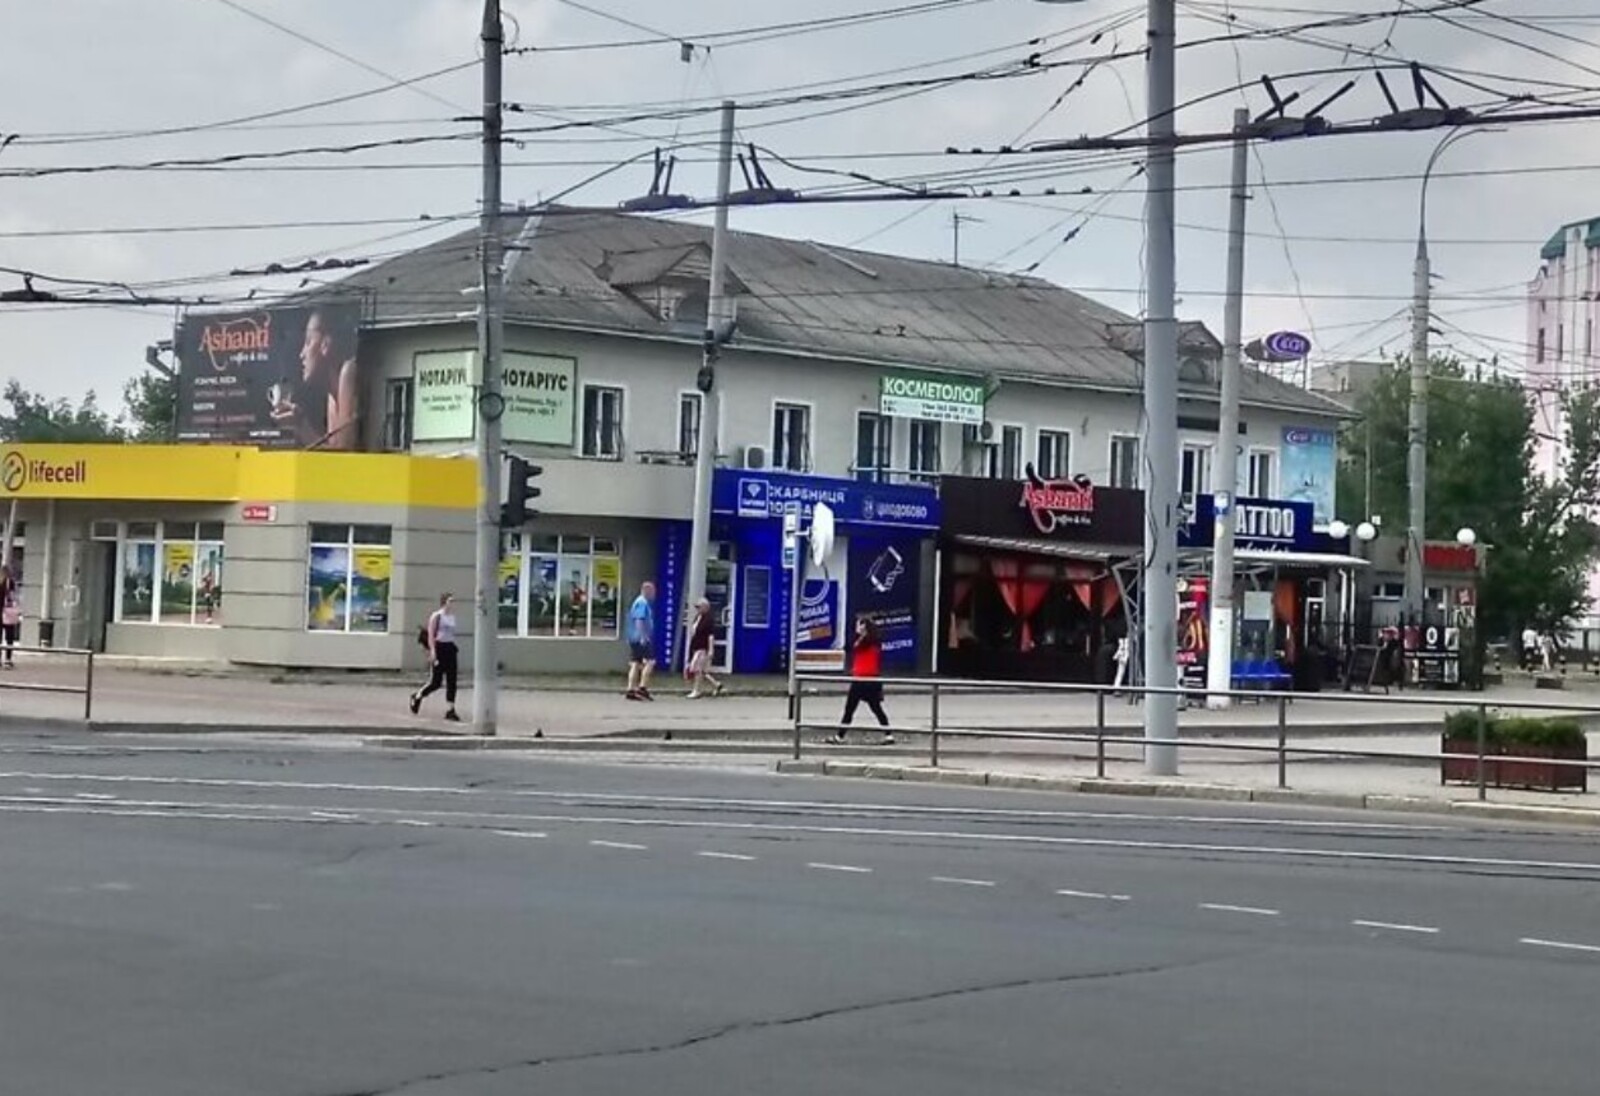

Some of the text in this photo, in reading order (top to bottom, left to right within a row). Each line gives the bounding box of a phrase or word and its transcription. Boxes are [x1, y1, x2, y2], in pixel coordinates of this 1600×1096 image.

[198, 314, 270, 354] Ashanti
[419, 368, 467, 387] НОТАРІУ
[884, 376, 983, 403] КОСМЕТОЛОГ
[28, 460, 86, 483] lifecell
[1235, 504, 1294, 538] ATTOO
